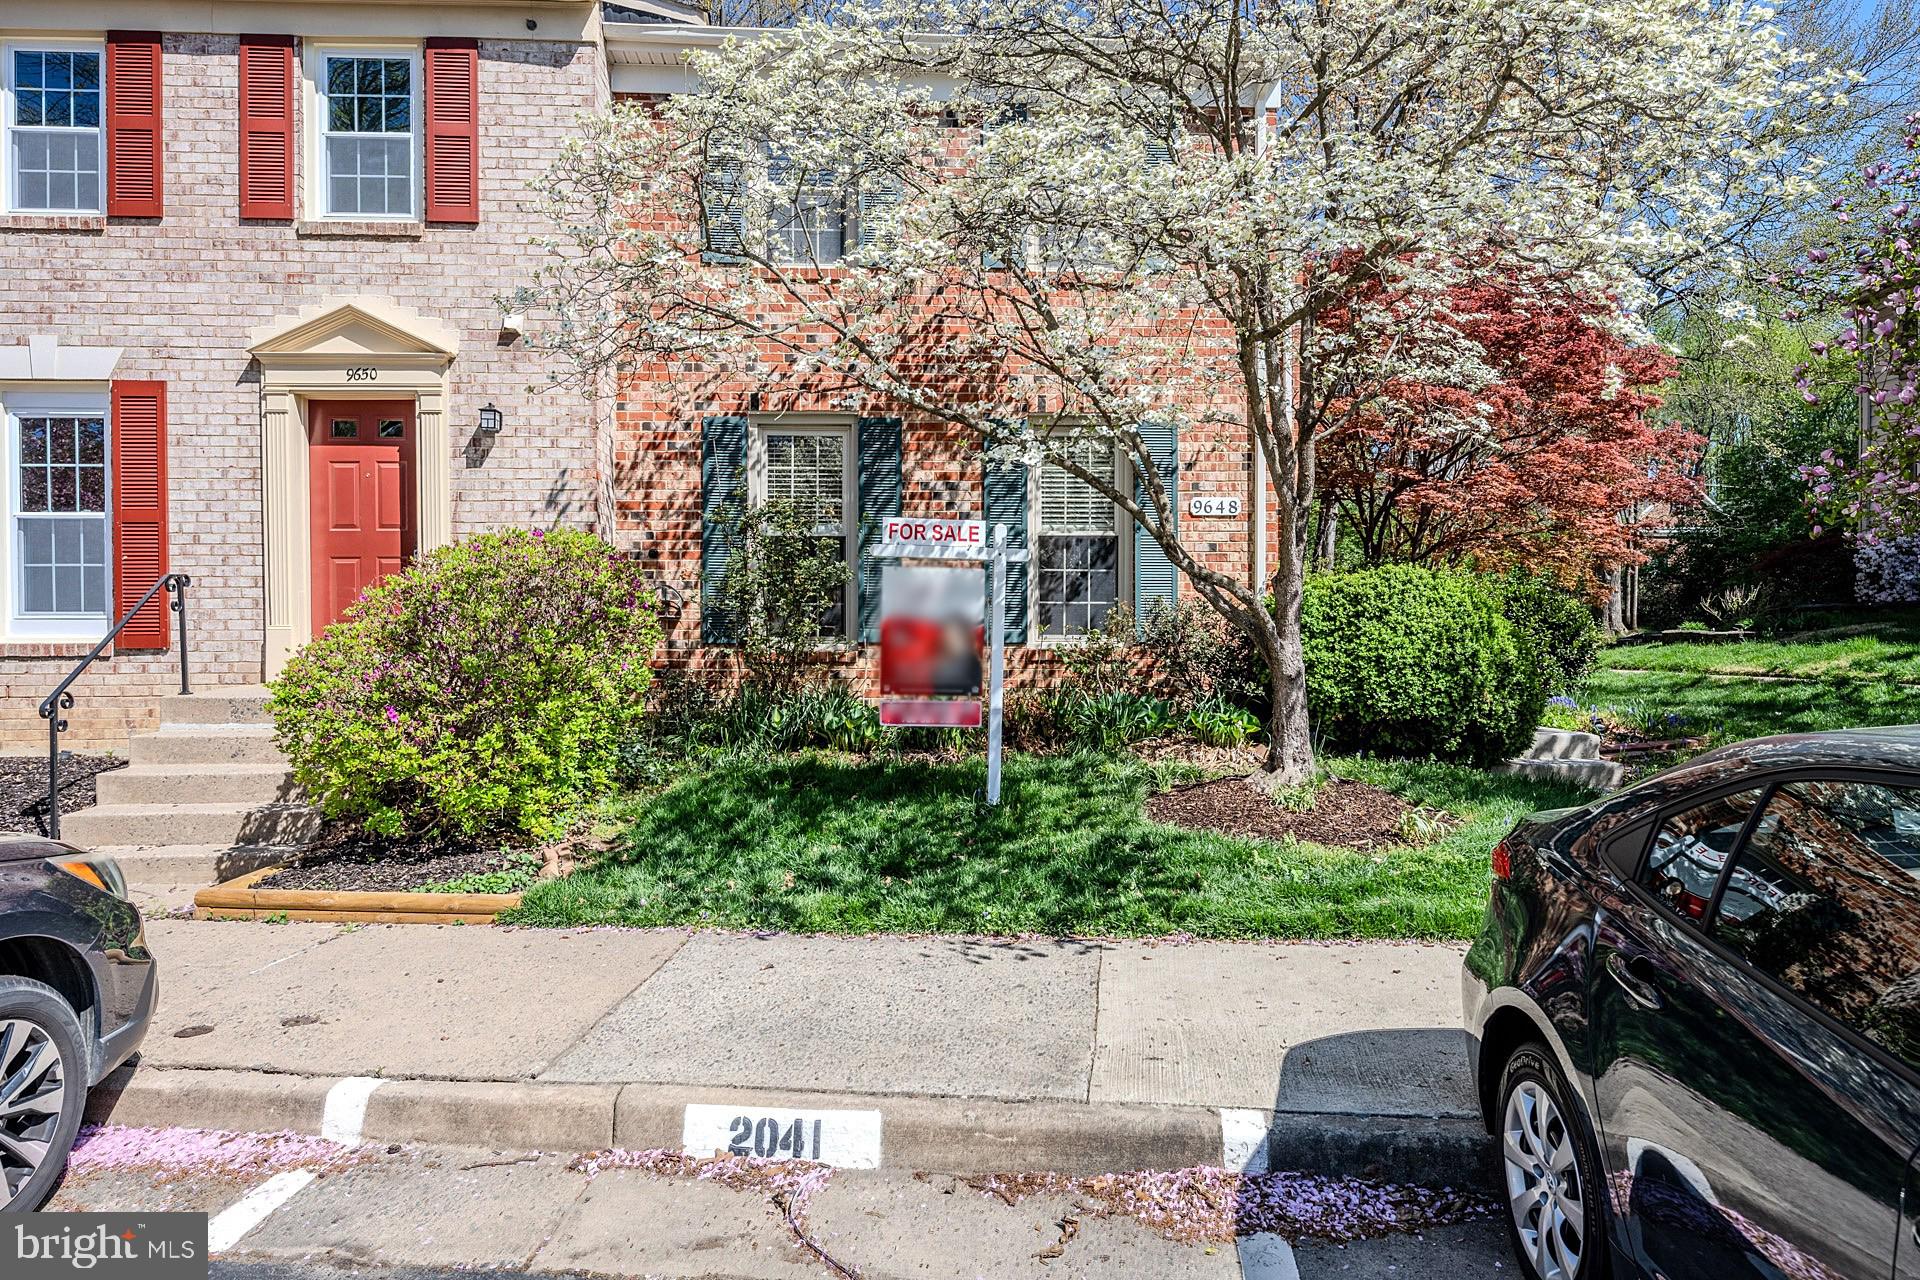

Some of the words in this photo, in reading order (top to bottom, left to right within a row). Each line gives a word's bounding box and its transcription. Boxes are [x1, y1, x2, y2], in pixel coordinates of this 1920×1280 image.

[346, 367, 378, 382] 9650
[1193, 500, 1238, 514] 9648
[888, 522, 926, 541] FOR
[932, 525, 980, 543] SALE
[728, 1115, 822, 1160] 2041
